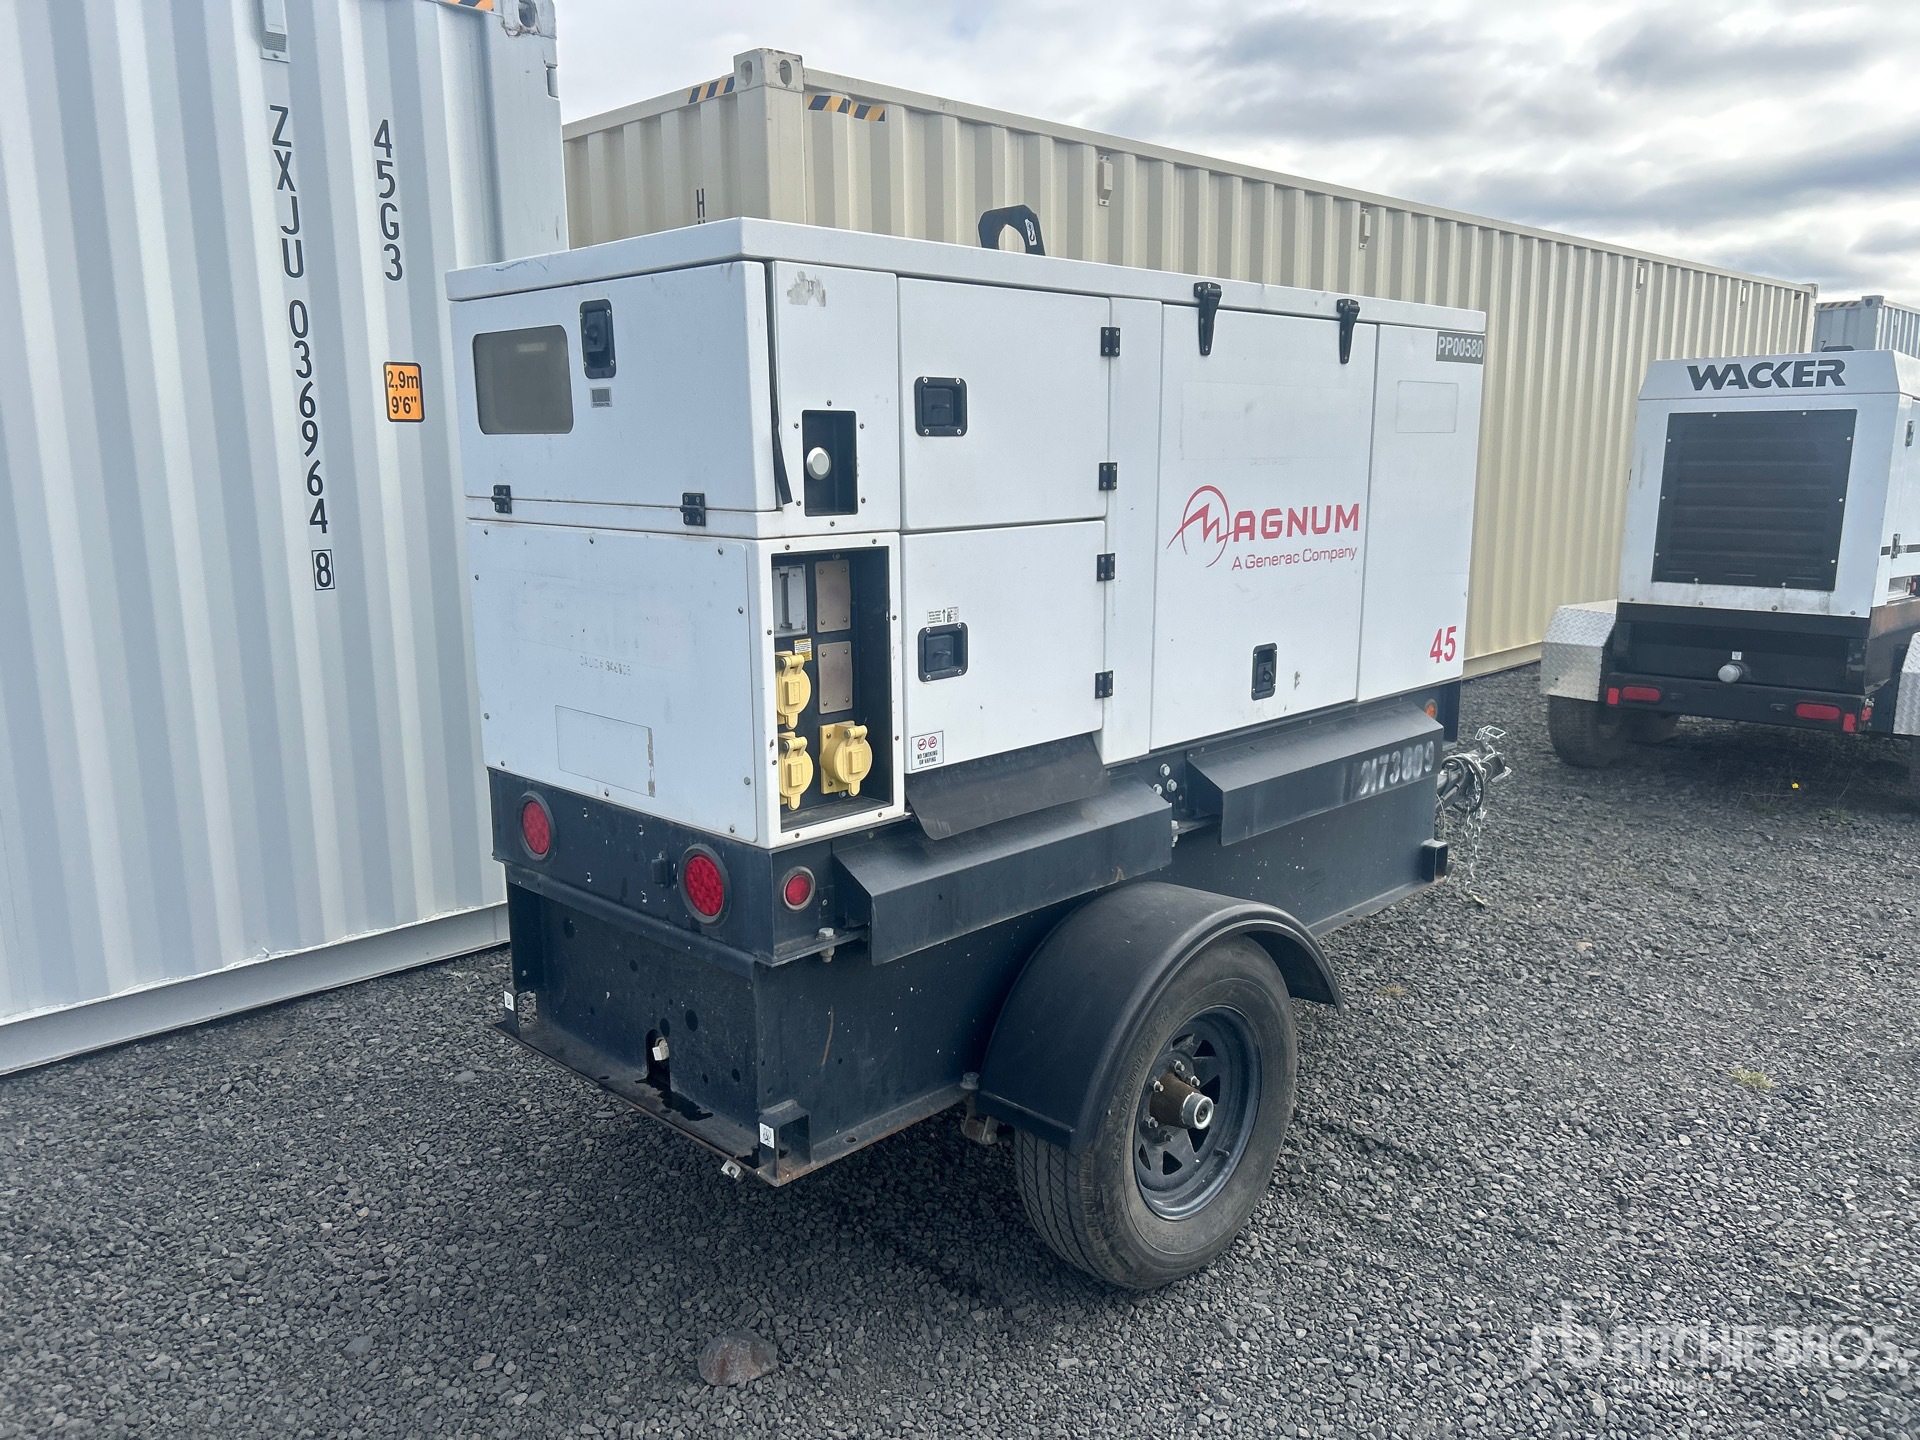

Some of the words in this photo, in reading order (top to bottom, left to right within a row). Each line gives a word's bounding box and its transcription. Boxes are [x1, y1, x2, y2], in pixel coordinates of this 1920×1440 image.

[374, 119, 403, 281] 45G3
[269, 105, 304, 279] ZXJU
[289, 299, 328, 534] 036964
[316, 553, 333, 587] 8
[1437, 336, 1484, 358] PP00580
[387, 370, 419, 391] 2,9m
[1686, 359, 1847, 391] WACKER
[391, 396, 417, 415] 9'6"
[1231, 556, 1243, 571] A
[1245, 553, 1300, 571] Generac
[1302, 546, 1358, 563] Company
[1429, 625, 1457, 664] 45
